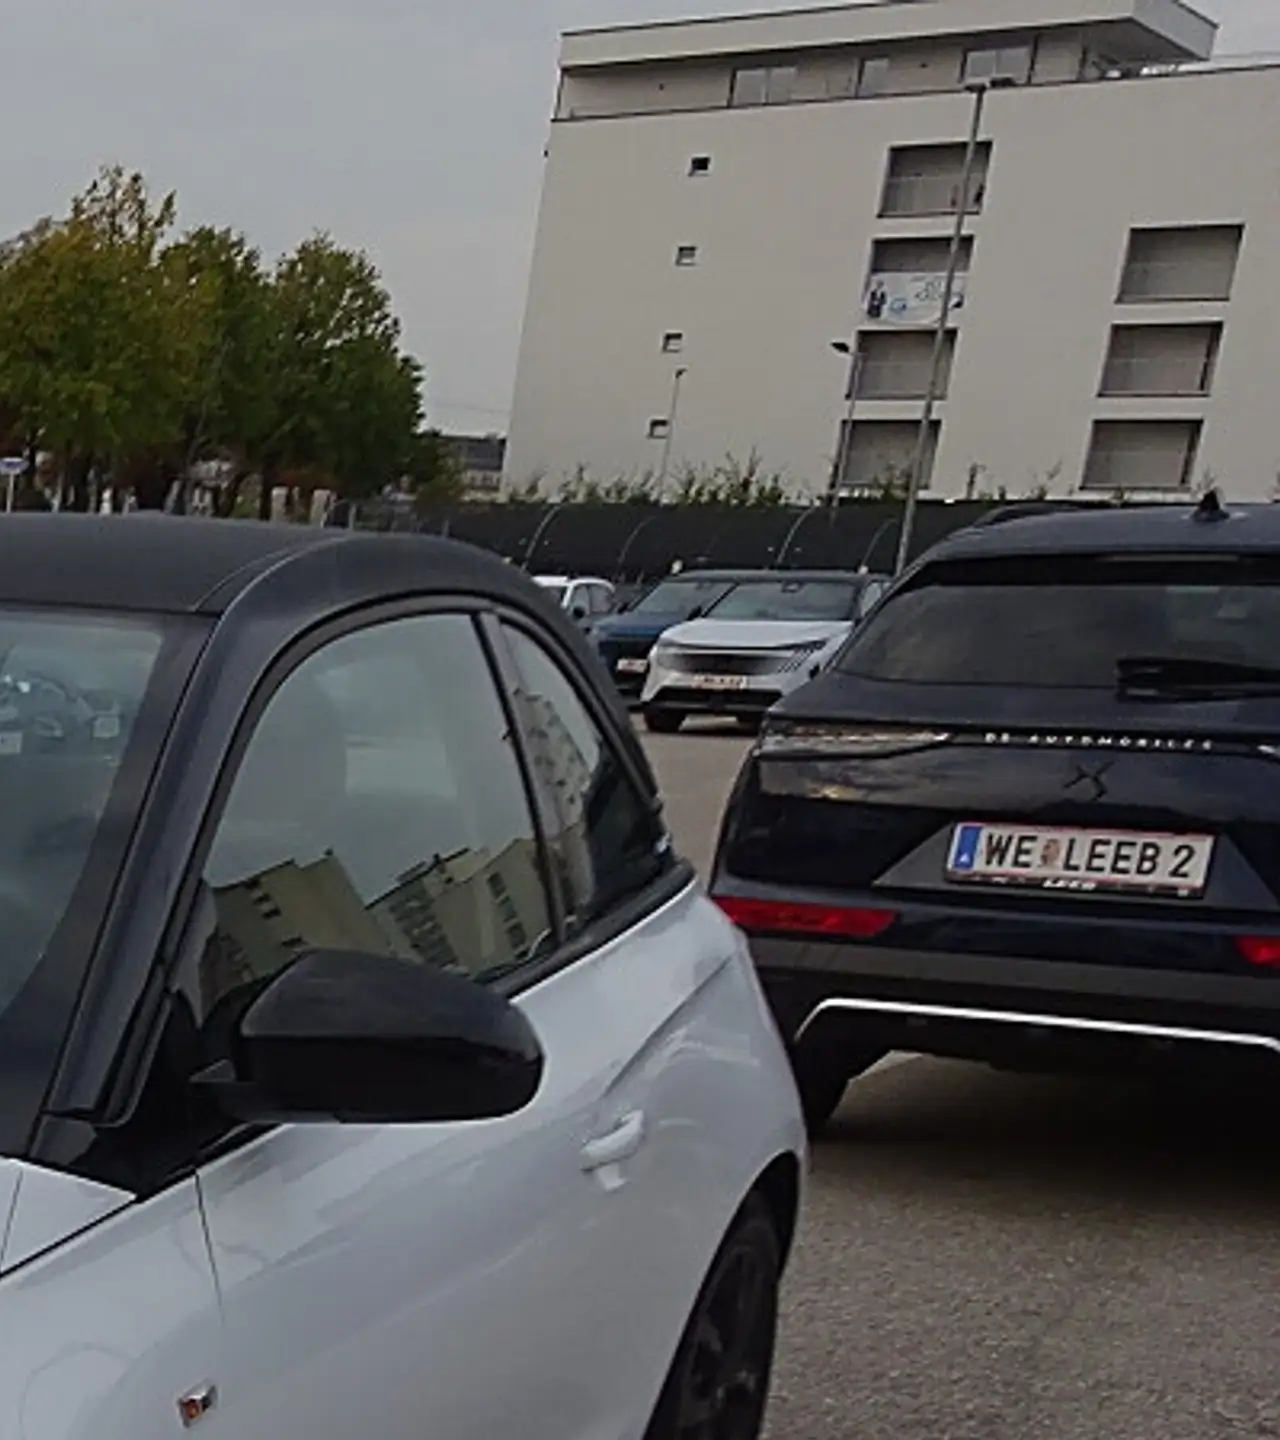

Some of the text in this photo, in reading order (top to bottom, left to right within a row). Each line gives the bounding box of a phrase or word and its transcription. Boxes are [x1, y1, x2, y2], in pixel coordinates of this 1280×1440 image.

[985, 833, 1037, 869] WE
[1062, 838, 1162, 876] LEEB
[1168, 844, 1195, 879] 2
